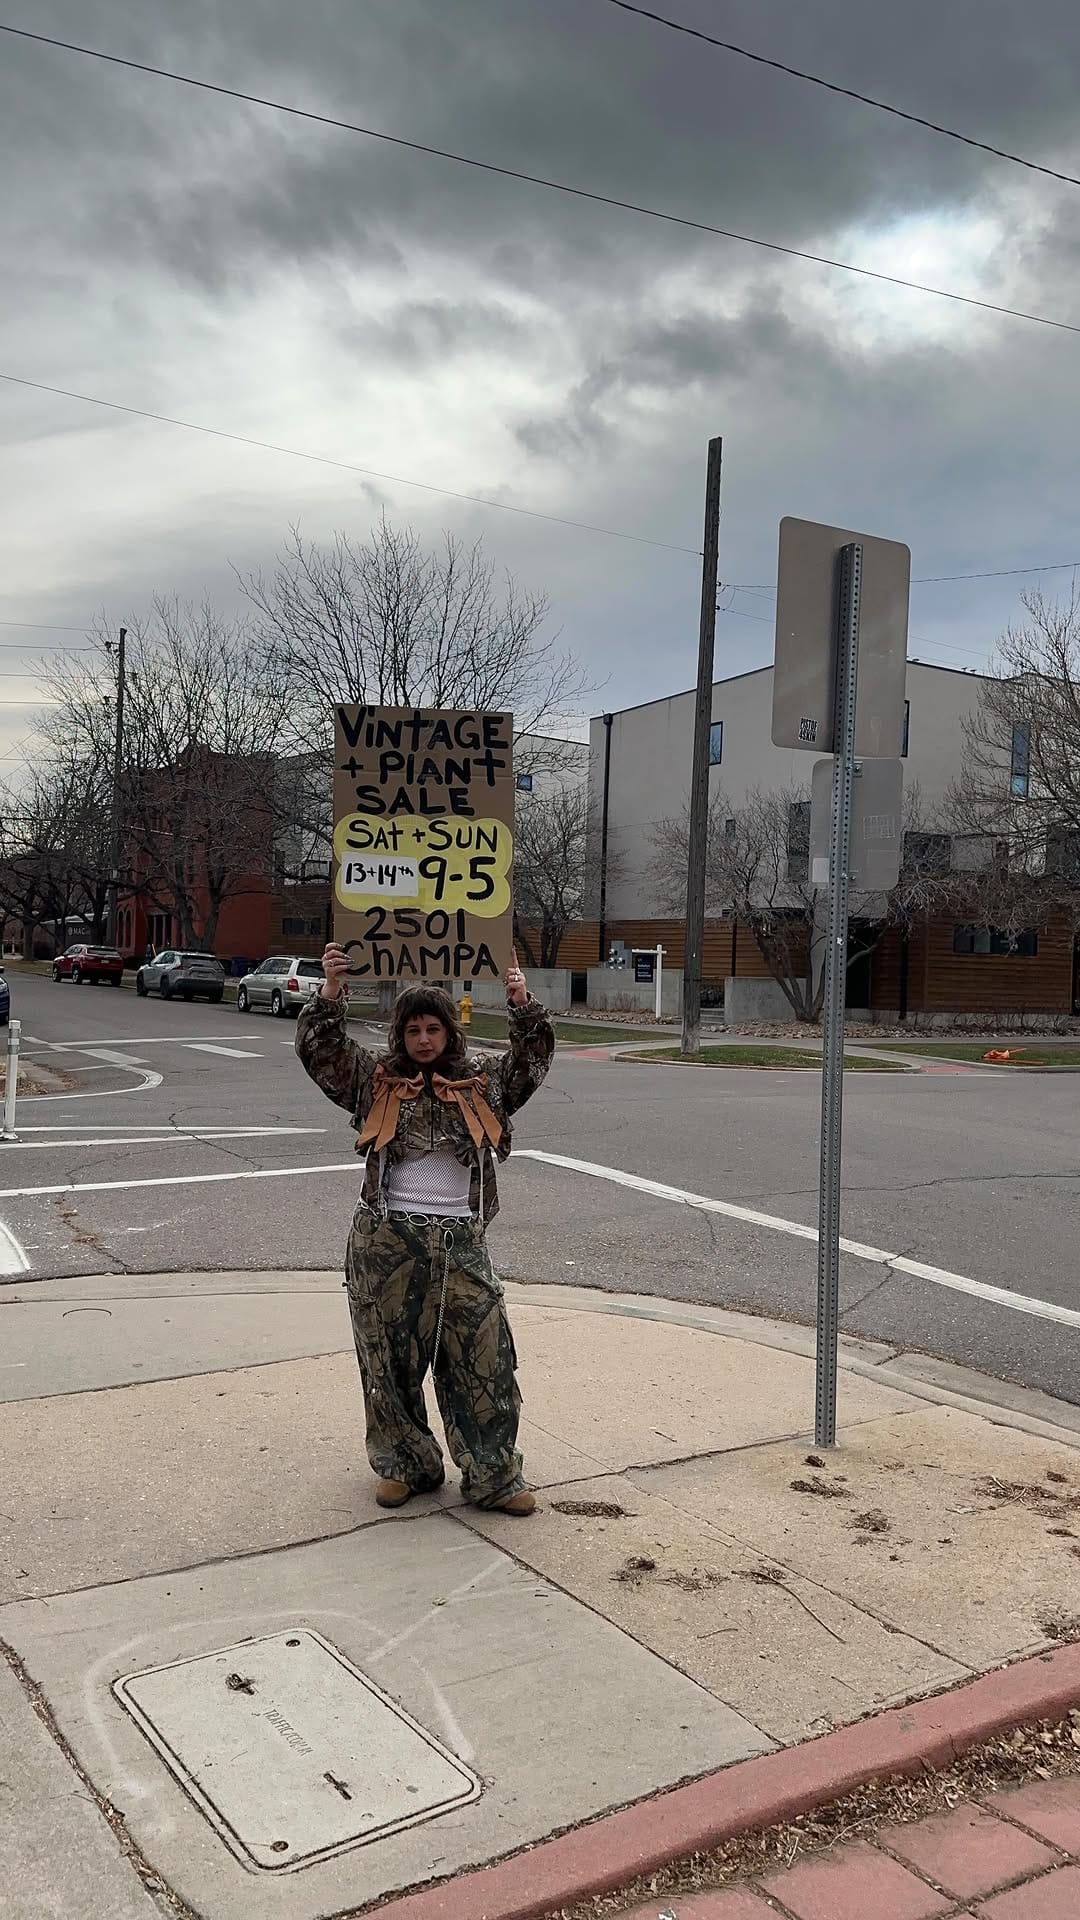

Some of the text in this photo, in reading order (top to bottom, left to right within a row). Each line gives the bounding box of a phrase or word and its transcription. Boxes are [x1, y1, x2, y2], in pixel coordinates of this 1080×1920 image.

[341, 755, 364, 778] +
[356, 785, 475, 816] SALE
[427, 820, 498, 853] SUN
[418, 856, 496, 900] 9-5
[363, 906, 466, 942] 2501
